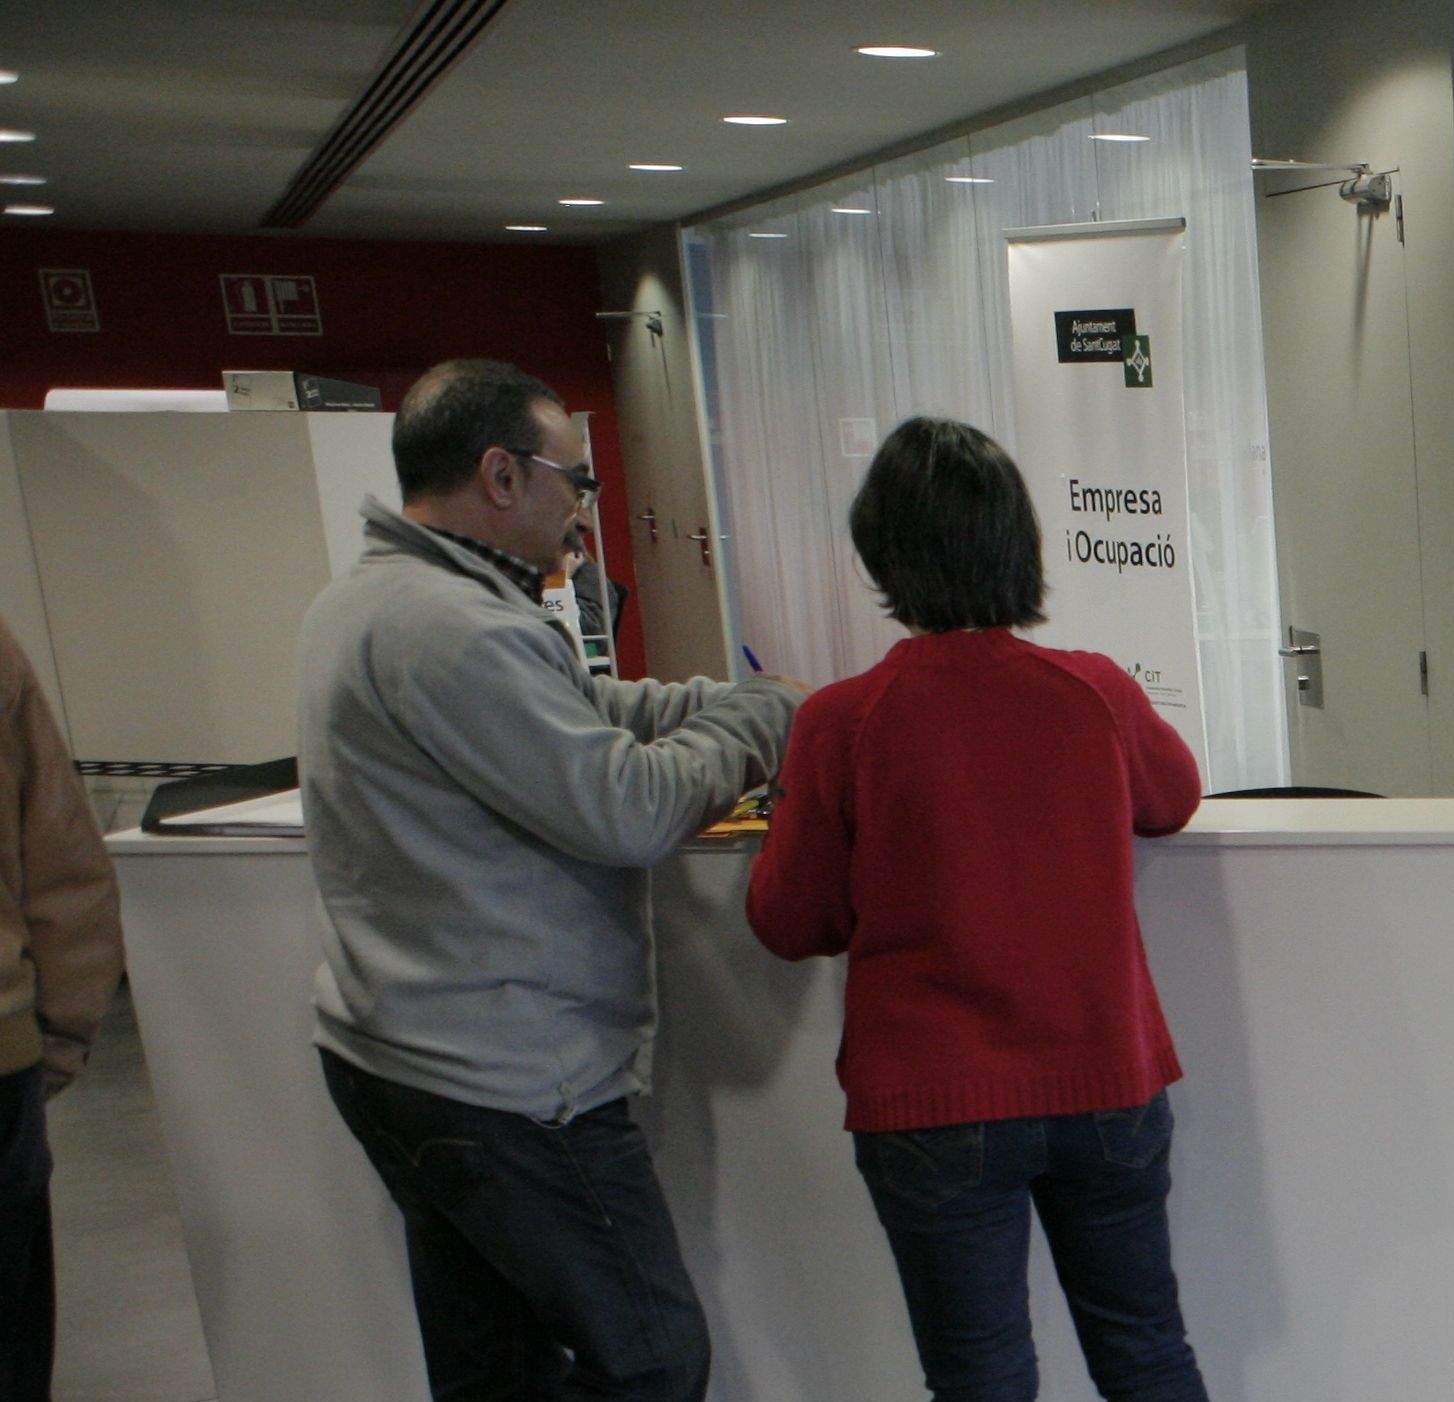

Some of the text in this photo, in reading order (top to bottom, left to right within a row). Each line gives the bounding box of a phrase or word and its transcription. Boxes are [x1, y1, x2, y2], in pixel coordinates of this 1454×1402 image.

[1072, 319, 1117, 336] Ajuntament
[1070, 338, 1082, 352] de
[1069, 479, 1162, 522] Empresa
[1066, 529, 1175, 574] i Ocupació
